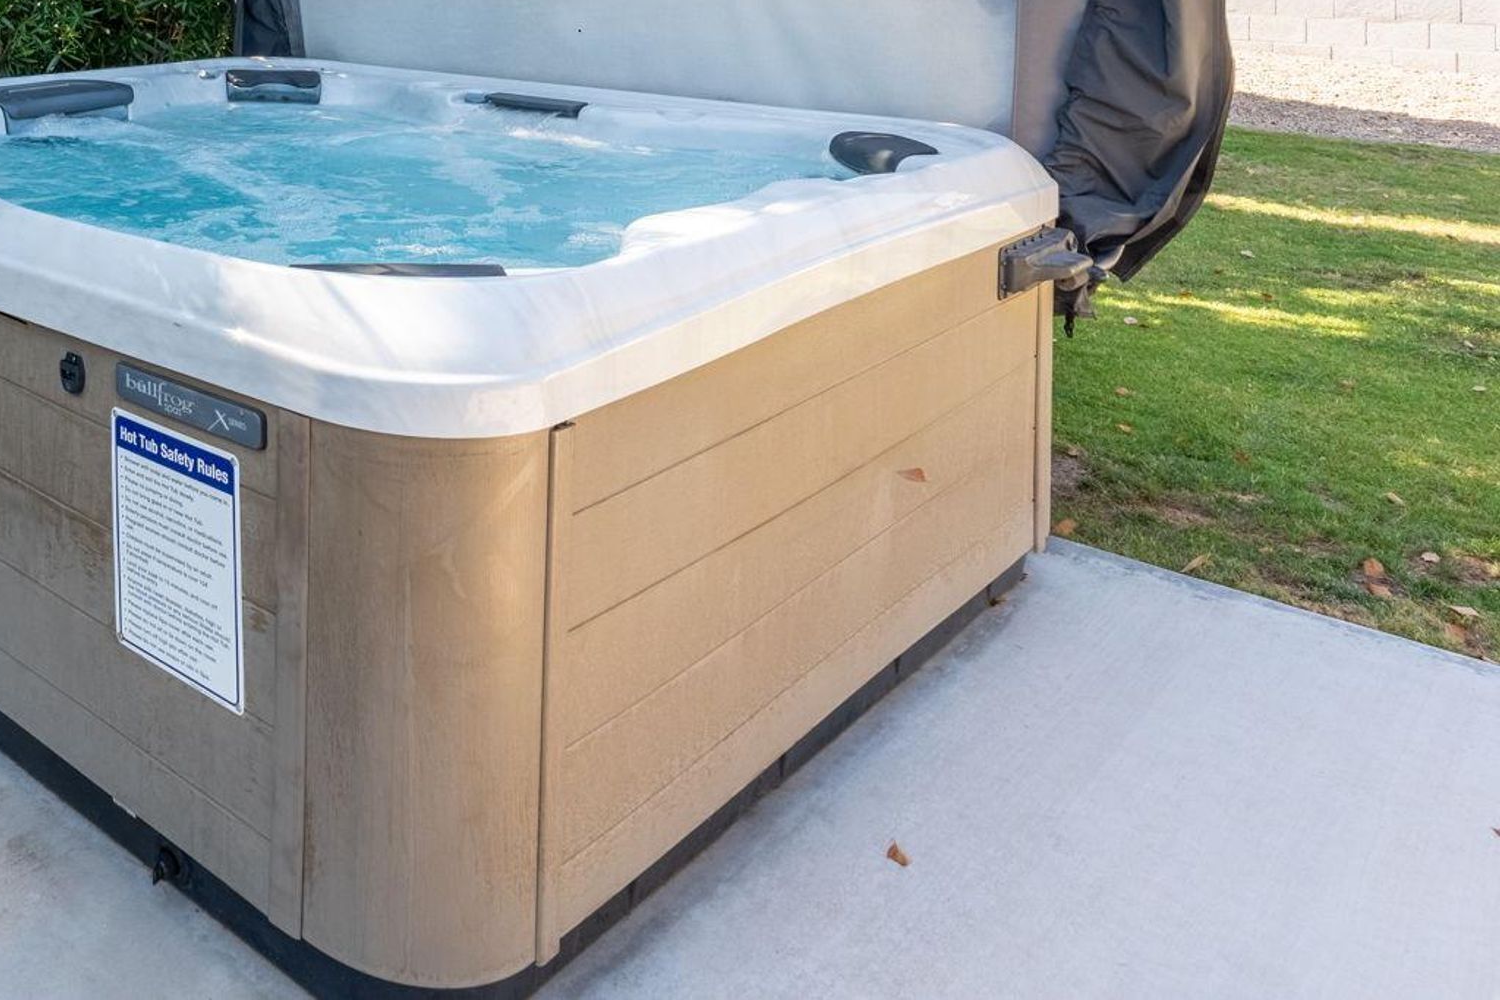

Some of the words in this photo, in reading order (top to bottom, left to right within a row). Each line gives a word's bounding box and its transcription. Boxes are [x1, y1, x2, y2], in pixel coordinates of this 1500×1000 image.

[126, 373, 197, 414] bullfrog
[120, 426, 137, 445] Hot
[138, 434, 158, 454] Tub
[160, 443, 195, 472] Safety
[197, 458, 229, 484] Rules
